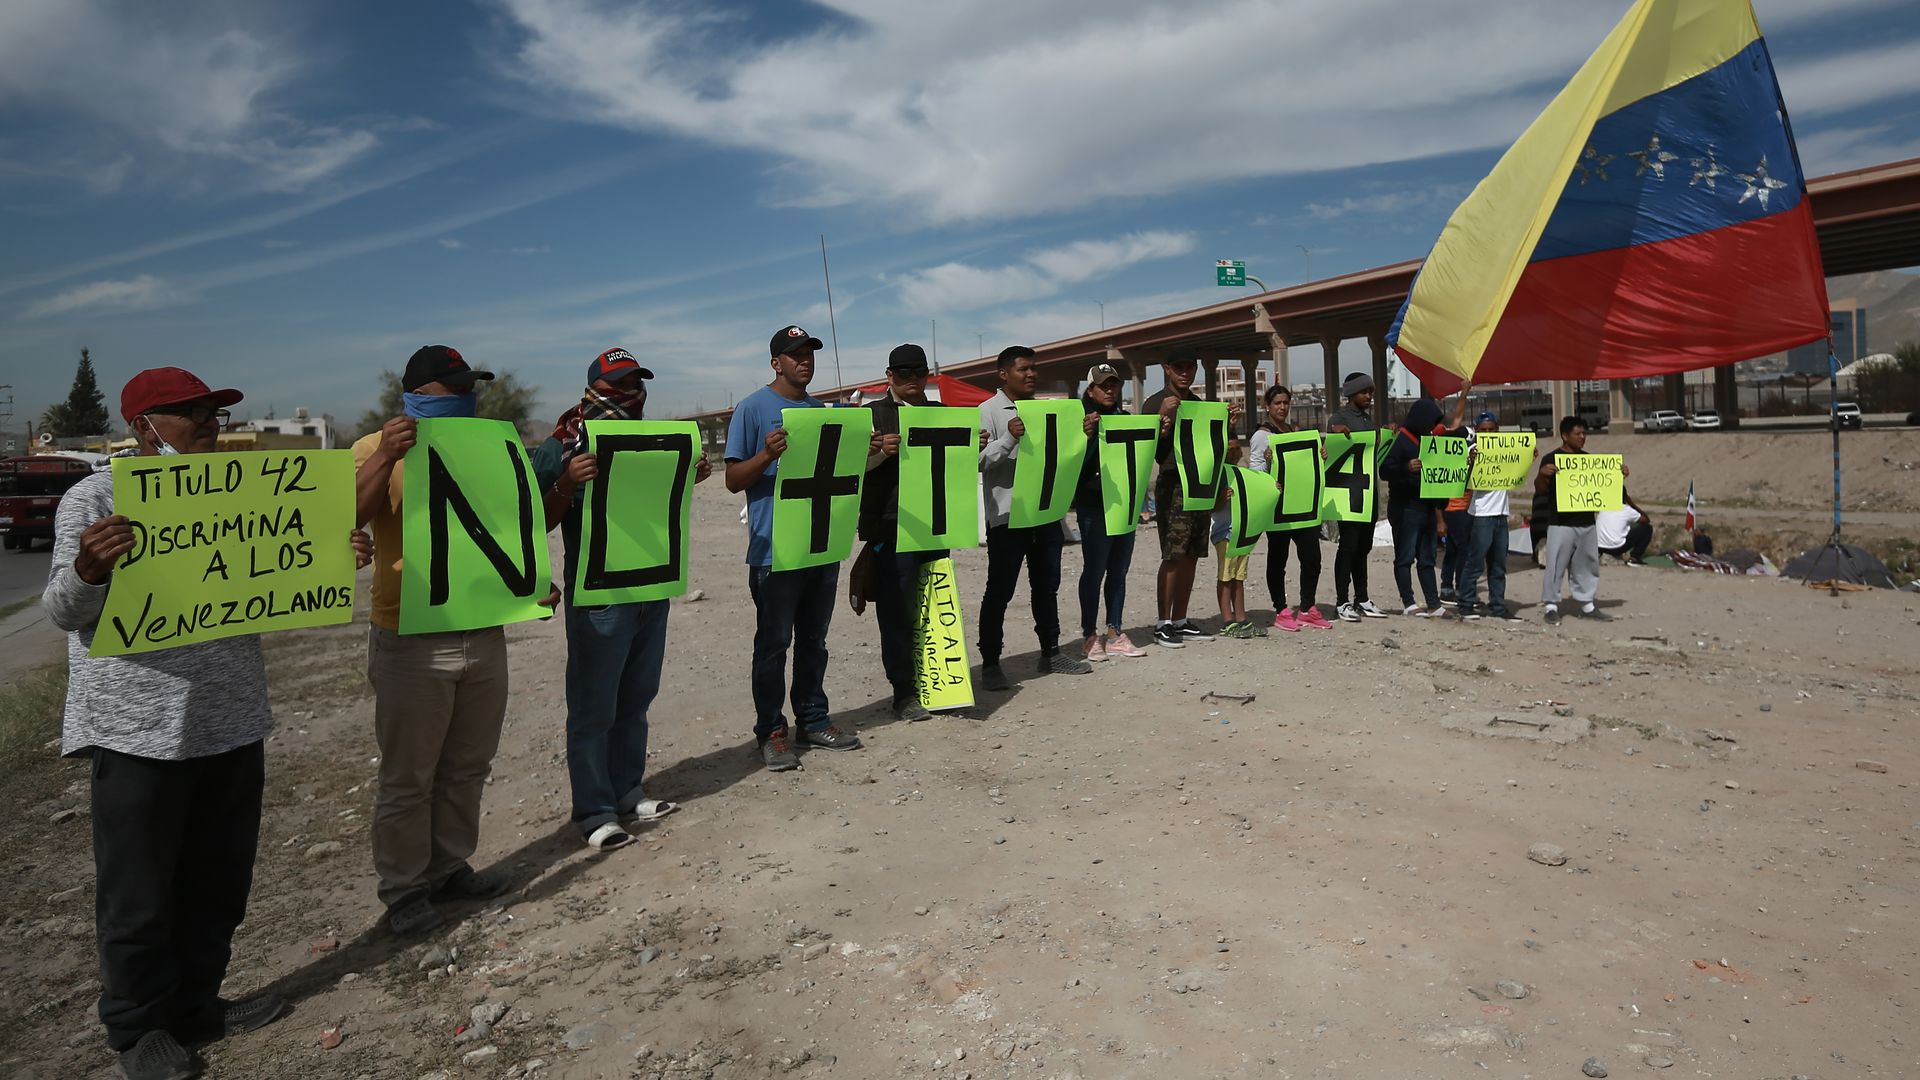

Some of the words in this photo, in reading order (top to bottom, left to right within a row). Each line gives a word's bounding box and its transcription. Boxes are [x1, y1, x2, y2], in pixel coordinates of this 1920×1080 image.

[1428, 436, 1437, 454] A
[1445, 440, 1464, 455] LOS
[1518, 436, 1530, 448] 42
[1478, 467, 1484, 475] A
[1487, 465, 1501, 475] LOS
[1559, 457, 1578, 470] LOS
[261, 455, 317, 496] 42
[1568, 472, 1612, 488] SOMOS
[202, 550, 229, 582] A
[249, 541, 313, 578] LOS
[931, 572, 957, 627] ALTO
[943, 636, 958, 650] A
[945, 657, 964, 685] LA
